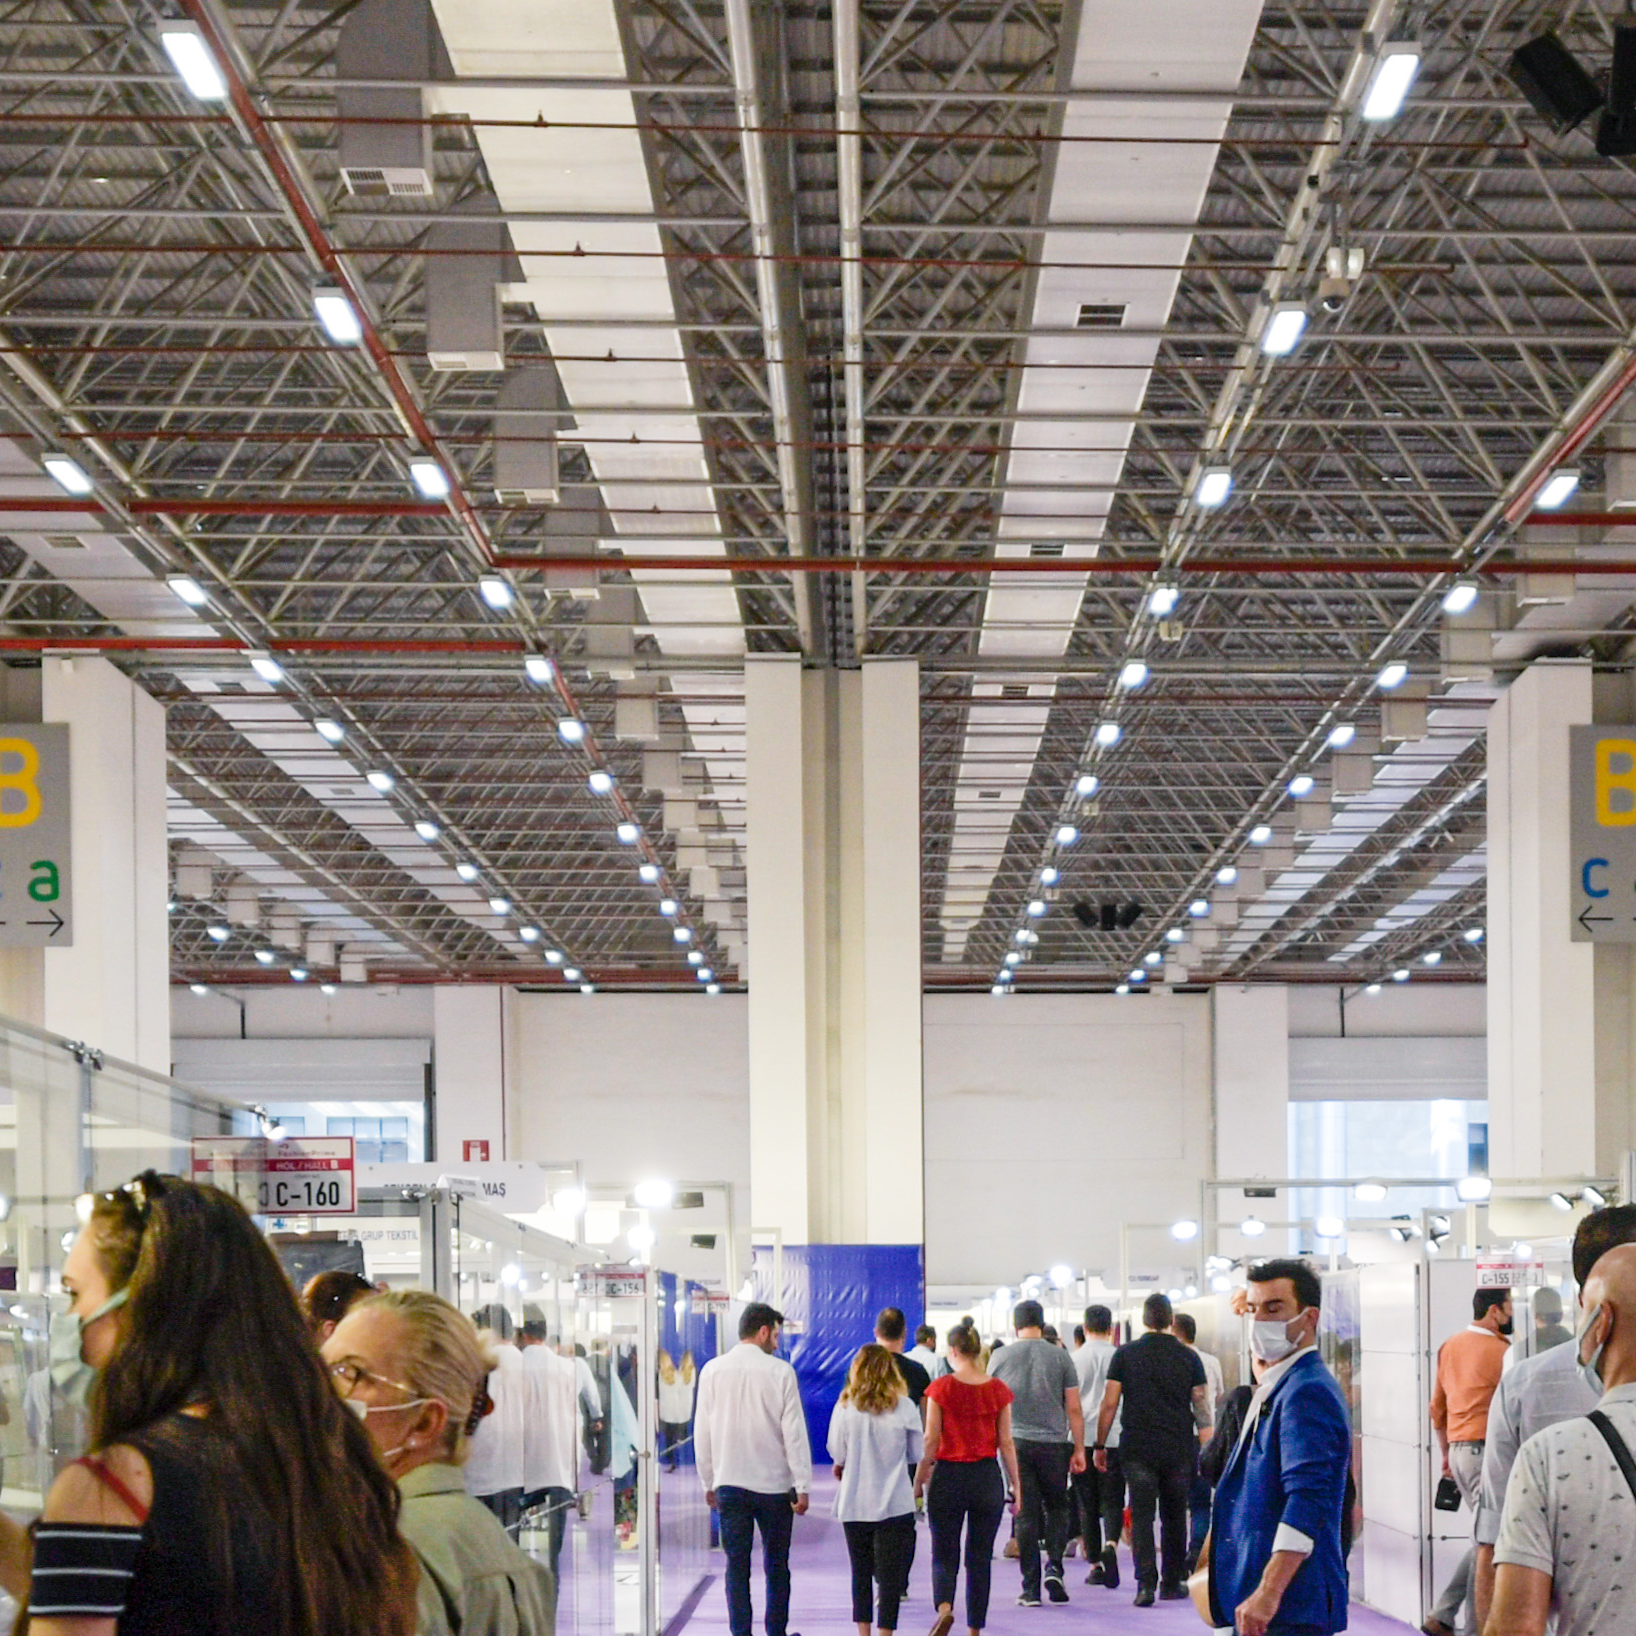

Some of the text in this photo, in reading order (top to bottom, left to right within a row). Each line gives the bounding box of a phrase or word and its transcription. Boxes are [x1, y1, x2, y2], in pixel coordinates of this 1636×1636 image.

[27, 860, 59, 902] a
[330, 1160, 338, 1169] B
[276, 1181, 340, 1207] C-160
